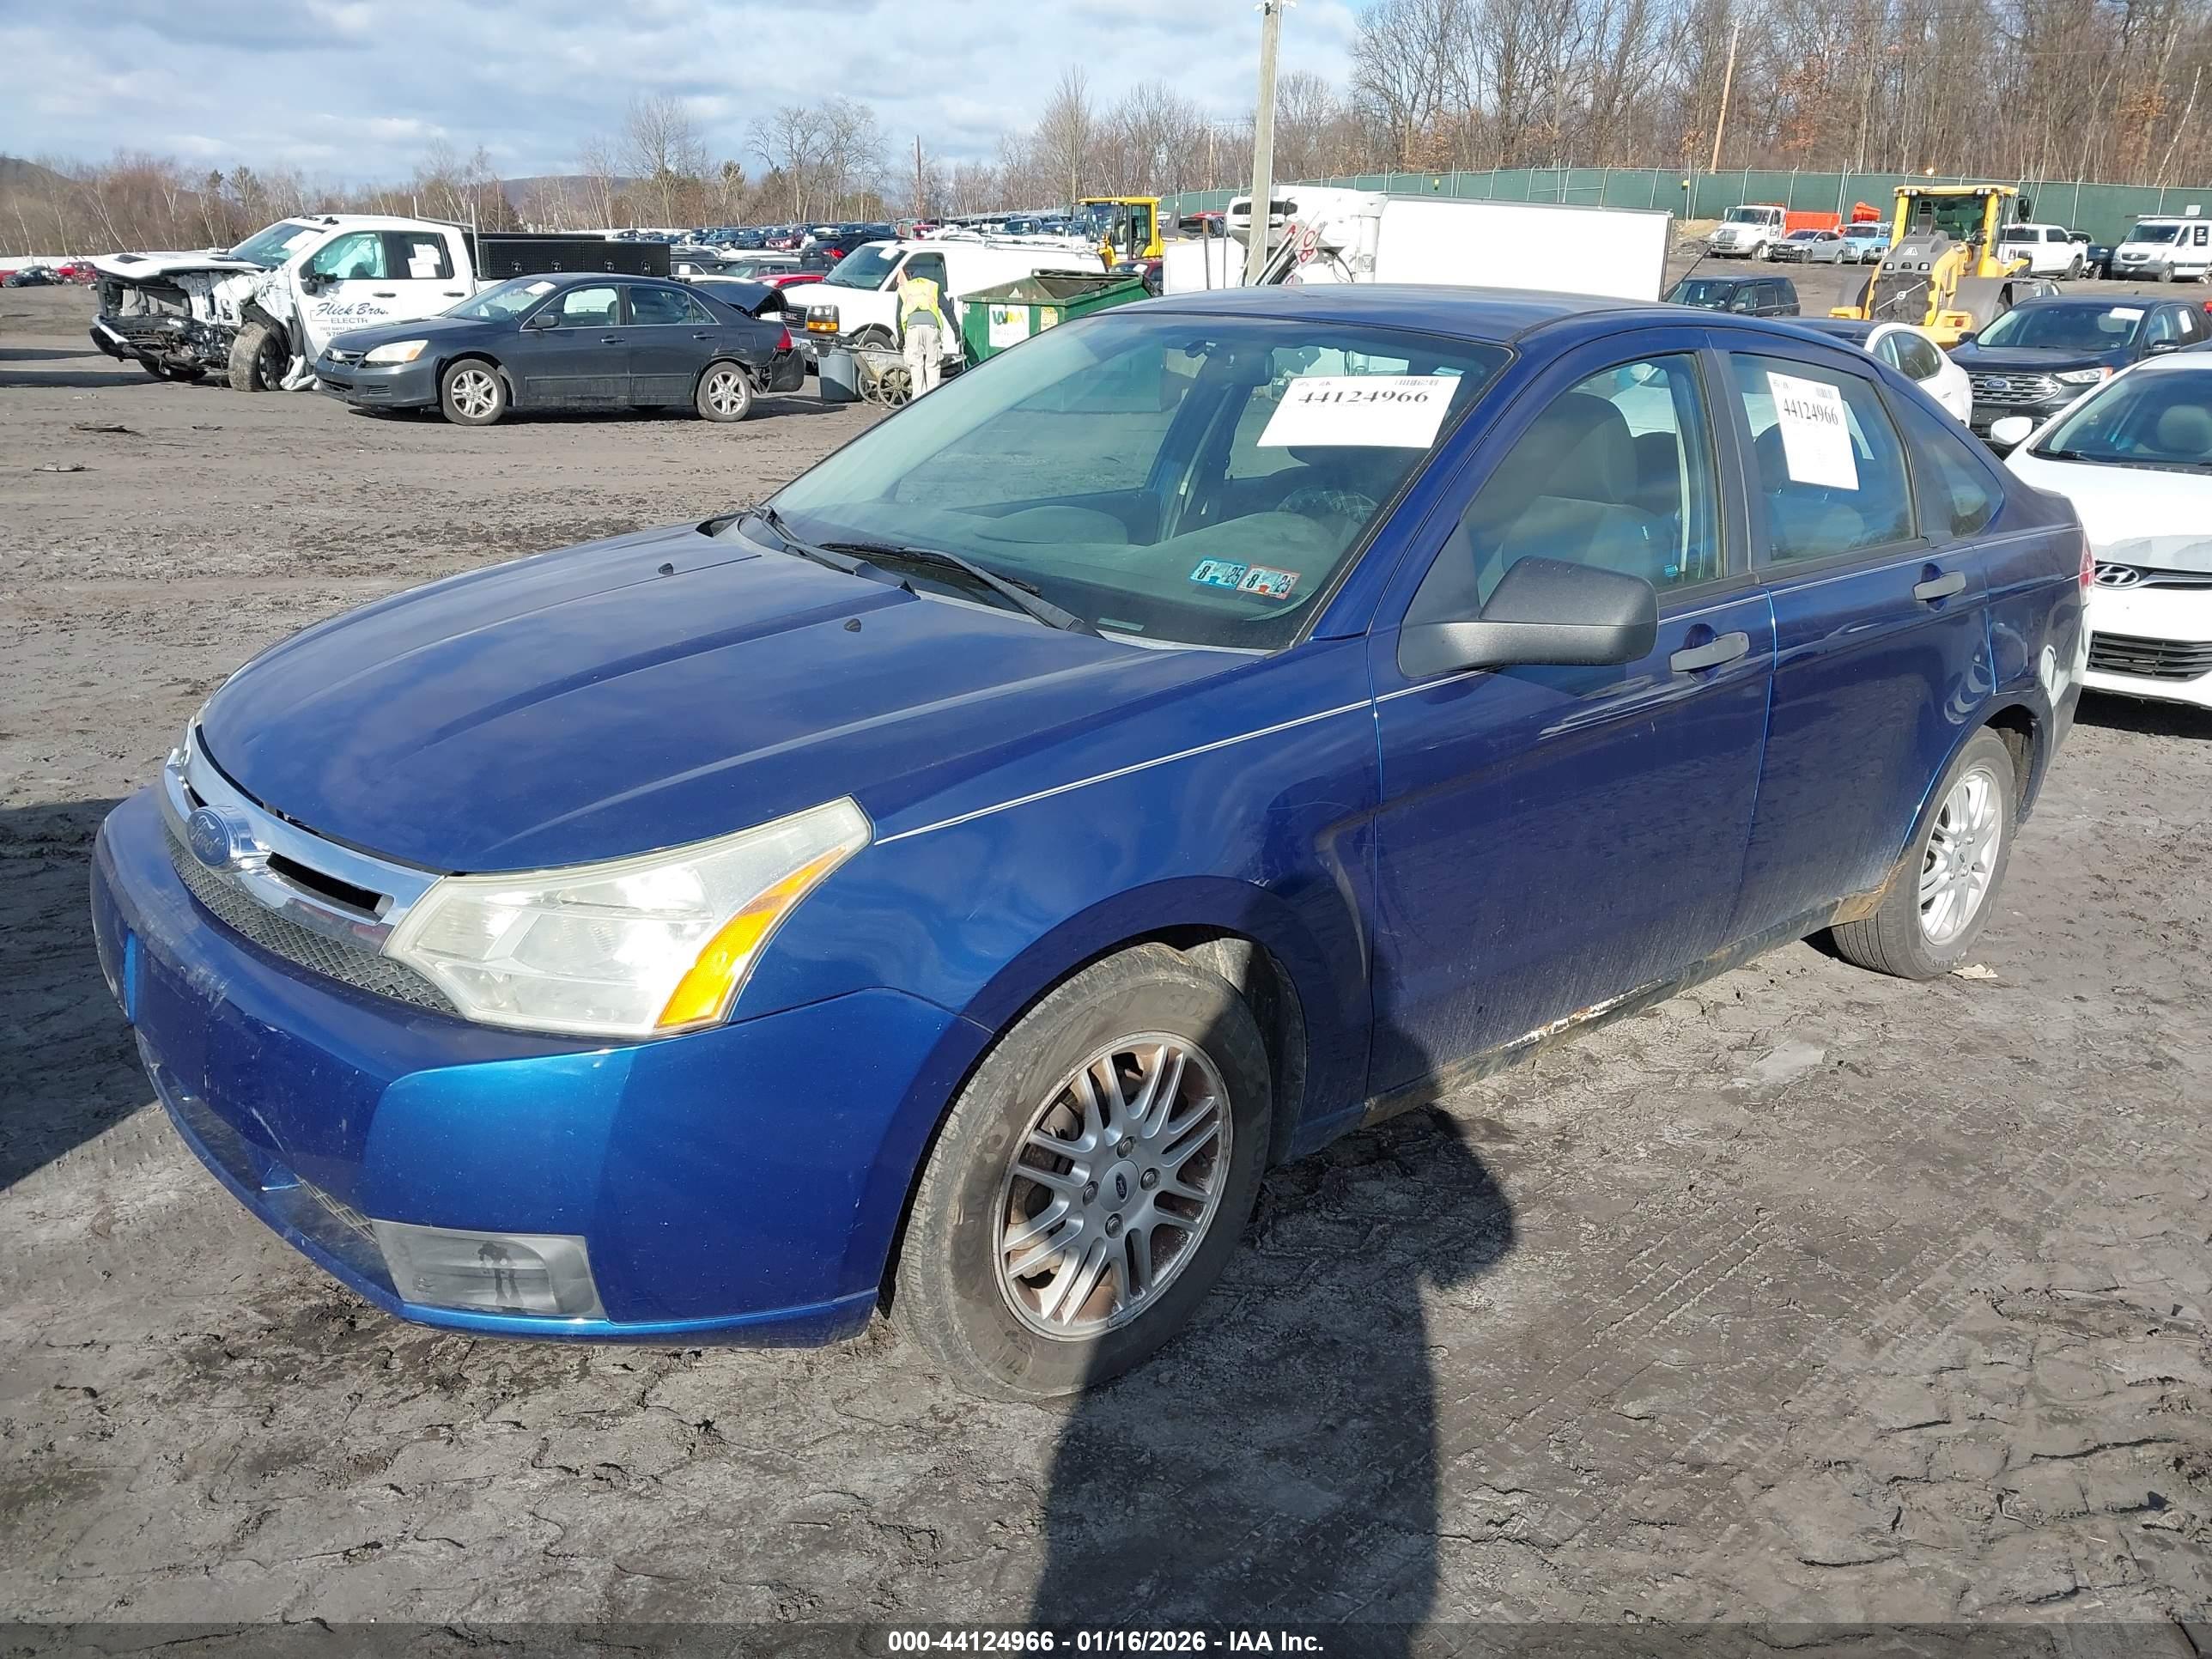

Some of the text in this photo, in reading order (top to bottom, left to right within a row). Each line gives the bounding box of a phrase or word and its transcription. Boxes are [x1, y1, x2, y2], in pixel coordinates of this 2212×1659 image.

[316, 302, 389, 316] Flick Bros.
[1297, 390, 1429, 404] 44124966
[1784, 398, 1838, 426] 44124966
[1197, 565, 1245, 584] 8 25
[1246, 574, 1261, 588] 8
[191, 815, 225, 854] Ford
